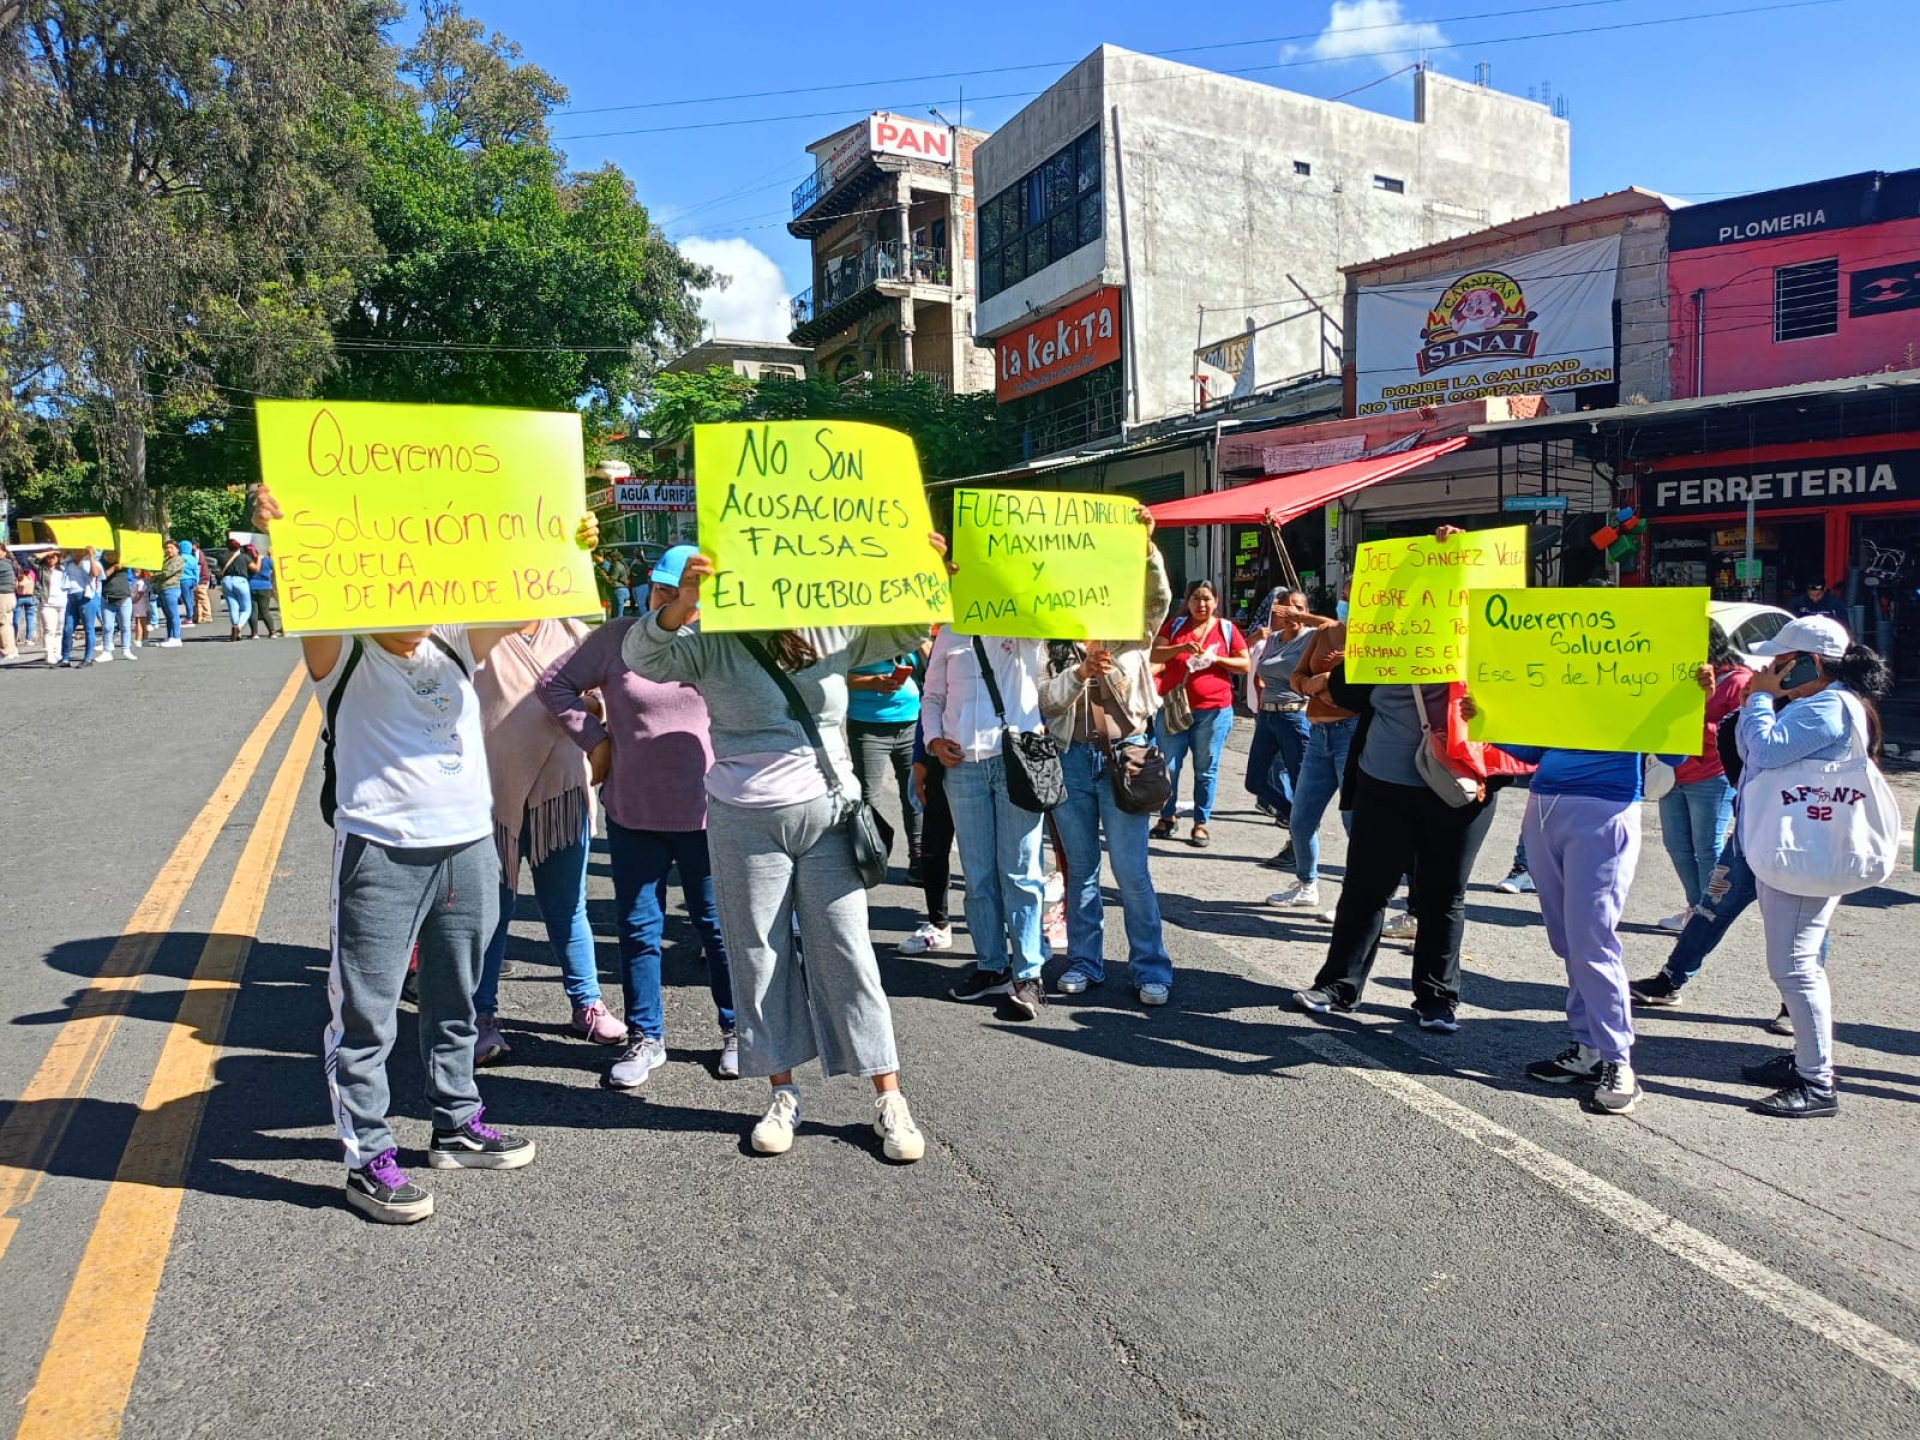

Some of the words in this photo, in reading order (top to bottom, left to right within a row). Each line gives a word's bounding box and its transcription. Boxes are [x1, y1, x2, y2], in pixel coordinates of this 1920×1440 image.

[876, 123, 946, 156] PAN
[1719, 209, 1826, 242] PLOMERIA
[1002, 345, 1021, 381] la
[1428, 334, 1525, 363] SINAI
[1382, 379, 1449, 399] DONDE
[1453, 375, 1478, 388] LA
[1483, 358, 1581, 385] CALIDAD
[1359, 401, 1388, 415] NO
[1391, 394, 1448, 412] TIENE
[307, 408, 500, 477] Queremos
[737, 425, 787, 477] NO
[620, 488, 650, 501] AGUA
[1656, 463, 1898, 507] FERRETERIA
[293, 495, 488, 549] Solución
[537, 495, 565, 541] la
[720, 483, 909, 528] ACUSACIONES
[957, 491, 1046, 528] FUERA
[1055, 497, 1080, 527] LA
[739, 527, 888, 558] FALSAS
[988, 532, 1096, 557] MAXIMINA
[1360, 547, 1399, 574] JOEL
[1407, 543, 1486, 567] SANCHEZ
[280, 552, 417, 583] ESCUELA
[289, 585, 319, 620] 5
[344, 583, 377, 612] DE
[388, 581, 465, 611] MAYO
[473, 580, 501, 604] DE
[512, 566, 582, 600] 1862
[711, 570, 755, 609] EL
[772, 578, 872, 609] PUEBLO
[963, 599, 1017, 623] ANA
[1034, 585, 1110, 614] MARIA!!
[1358, 582, 1409, 610] CUBRE
[1422, 589, 1436, 608] A
[1485, 594, 1616, 631] Queremos
[1348, 643, 1407, 660] HERMANO
[1415, 646, 1435, 659] ES
[1550, 631, 1651, 655] Solución
[1375, 666, 1398, 677] DE
[1411, 664, 1457, 676] ZONA
[1526, 663, 1546, 687] 5
[1561, 663, 1589, 685] de
[1597, 661, 1658, 696] Mayo
[1806, 805, 1833, 821] 92
